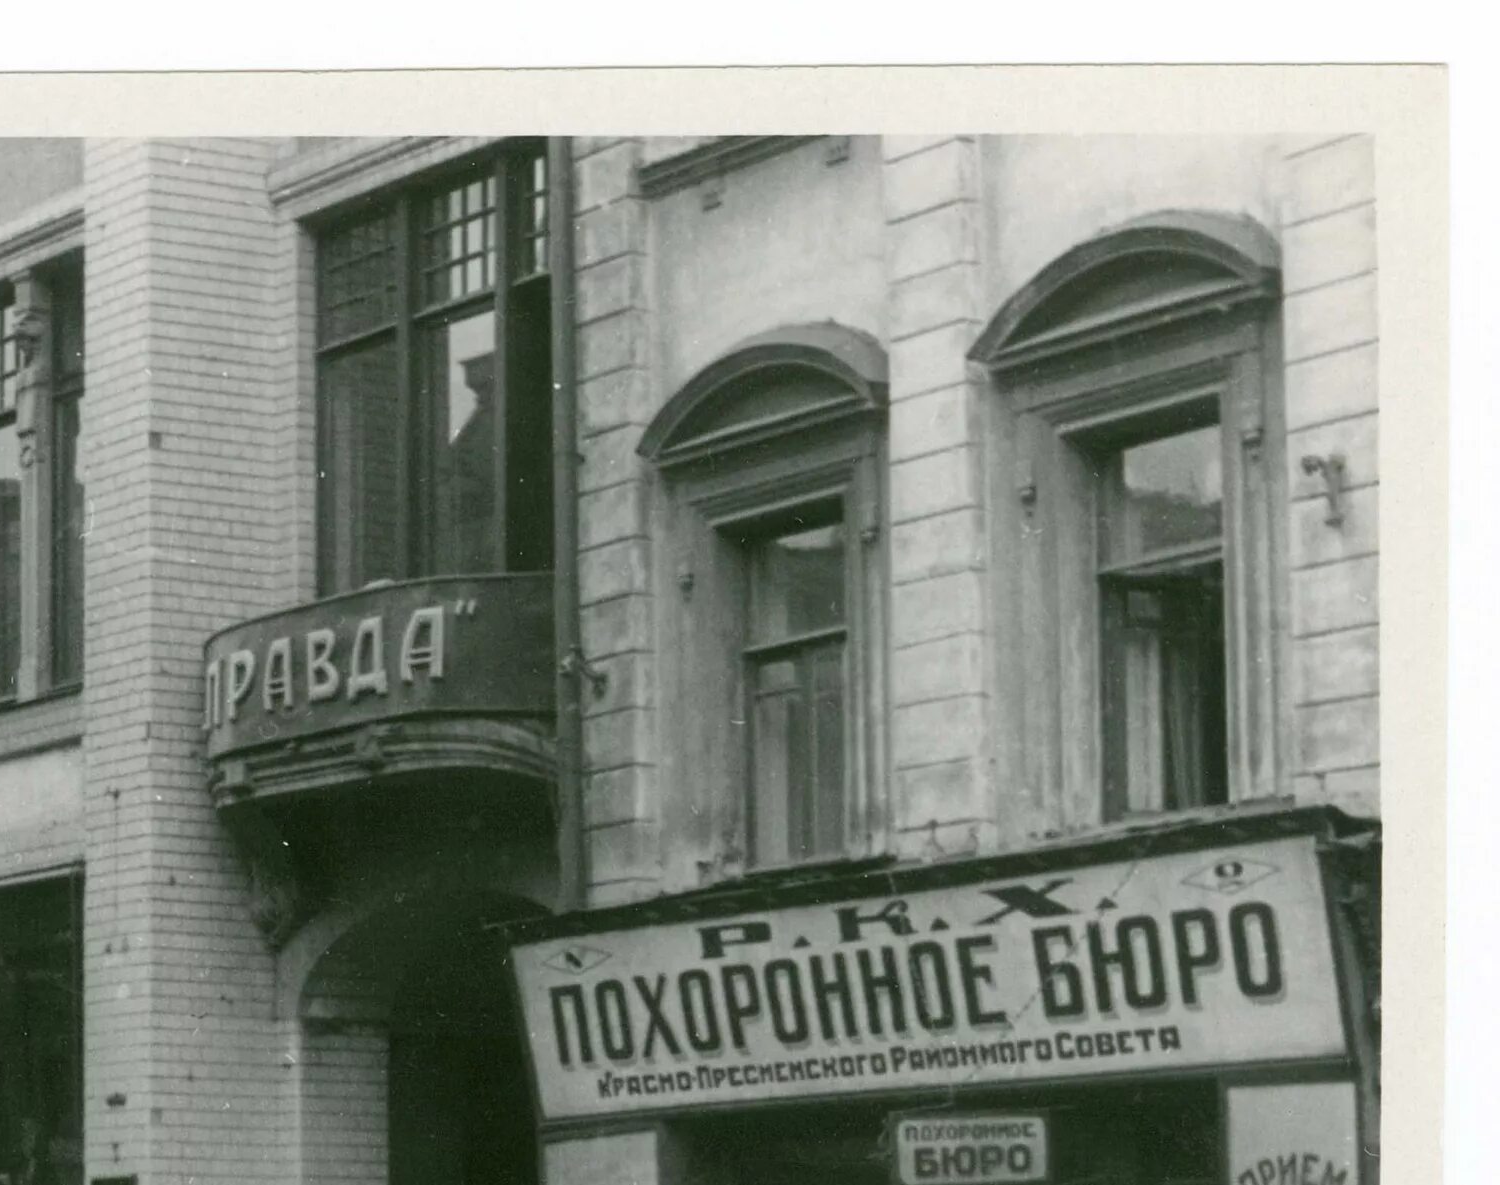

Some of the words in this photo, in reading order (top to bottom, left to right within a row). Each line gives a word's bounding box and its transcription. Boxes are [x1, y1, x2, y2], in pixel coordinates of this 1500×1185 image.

[549, 934, 1009, 1067] ПОХОРОННОЕ
[1031, 902, 1284, 1019] БЮРО
[905, 1122, 1038, 1142] ПОХОРОННОЕ
[915, 1143, 1033, 1179] БЮРО
